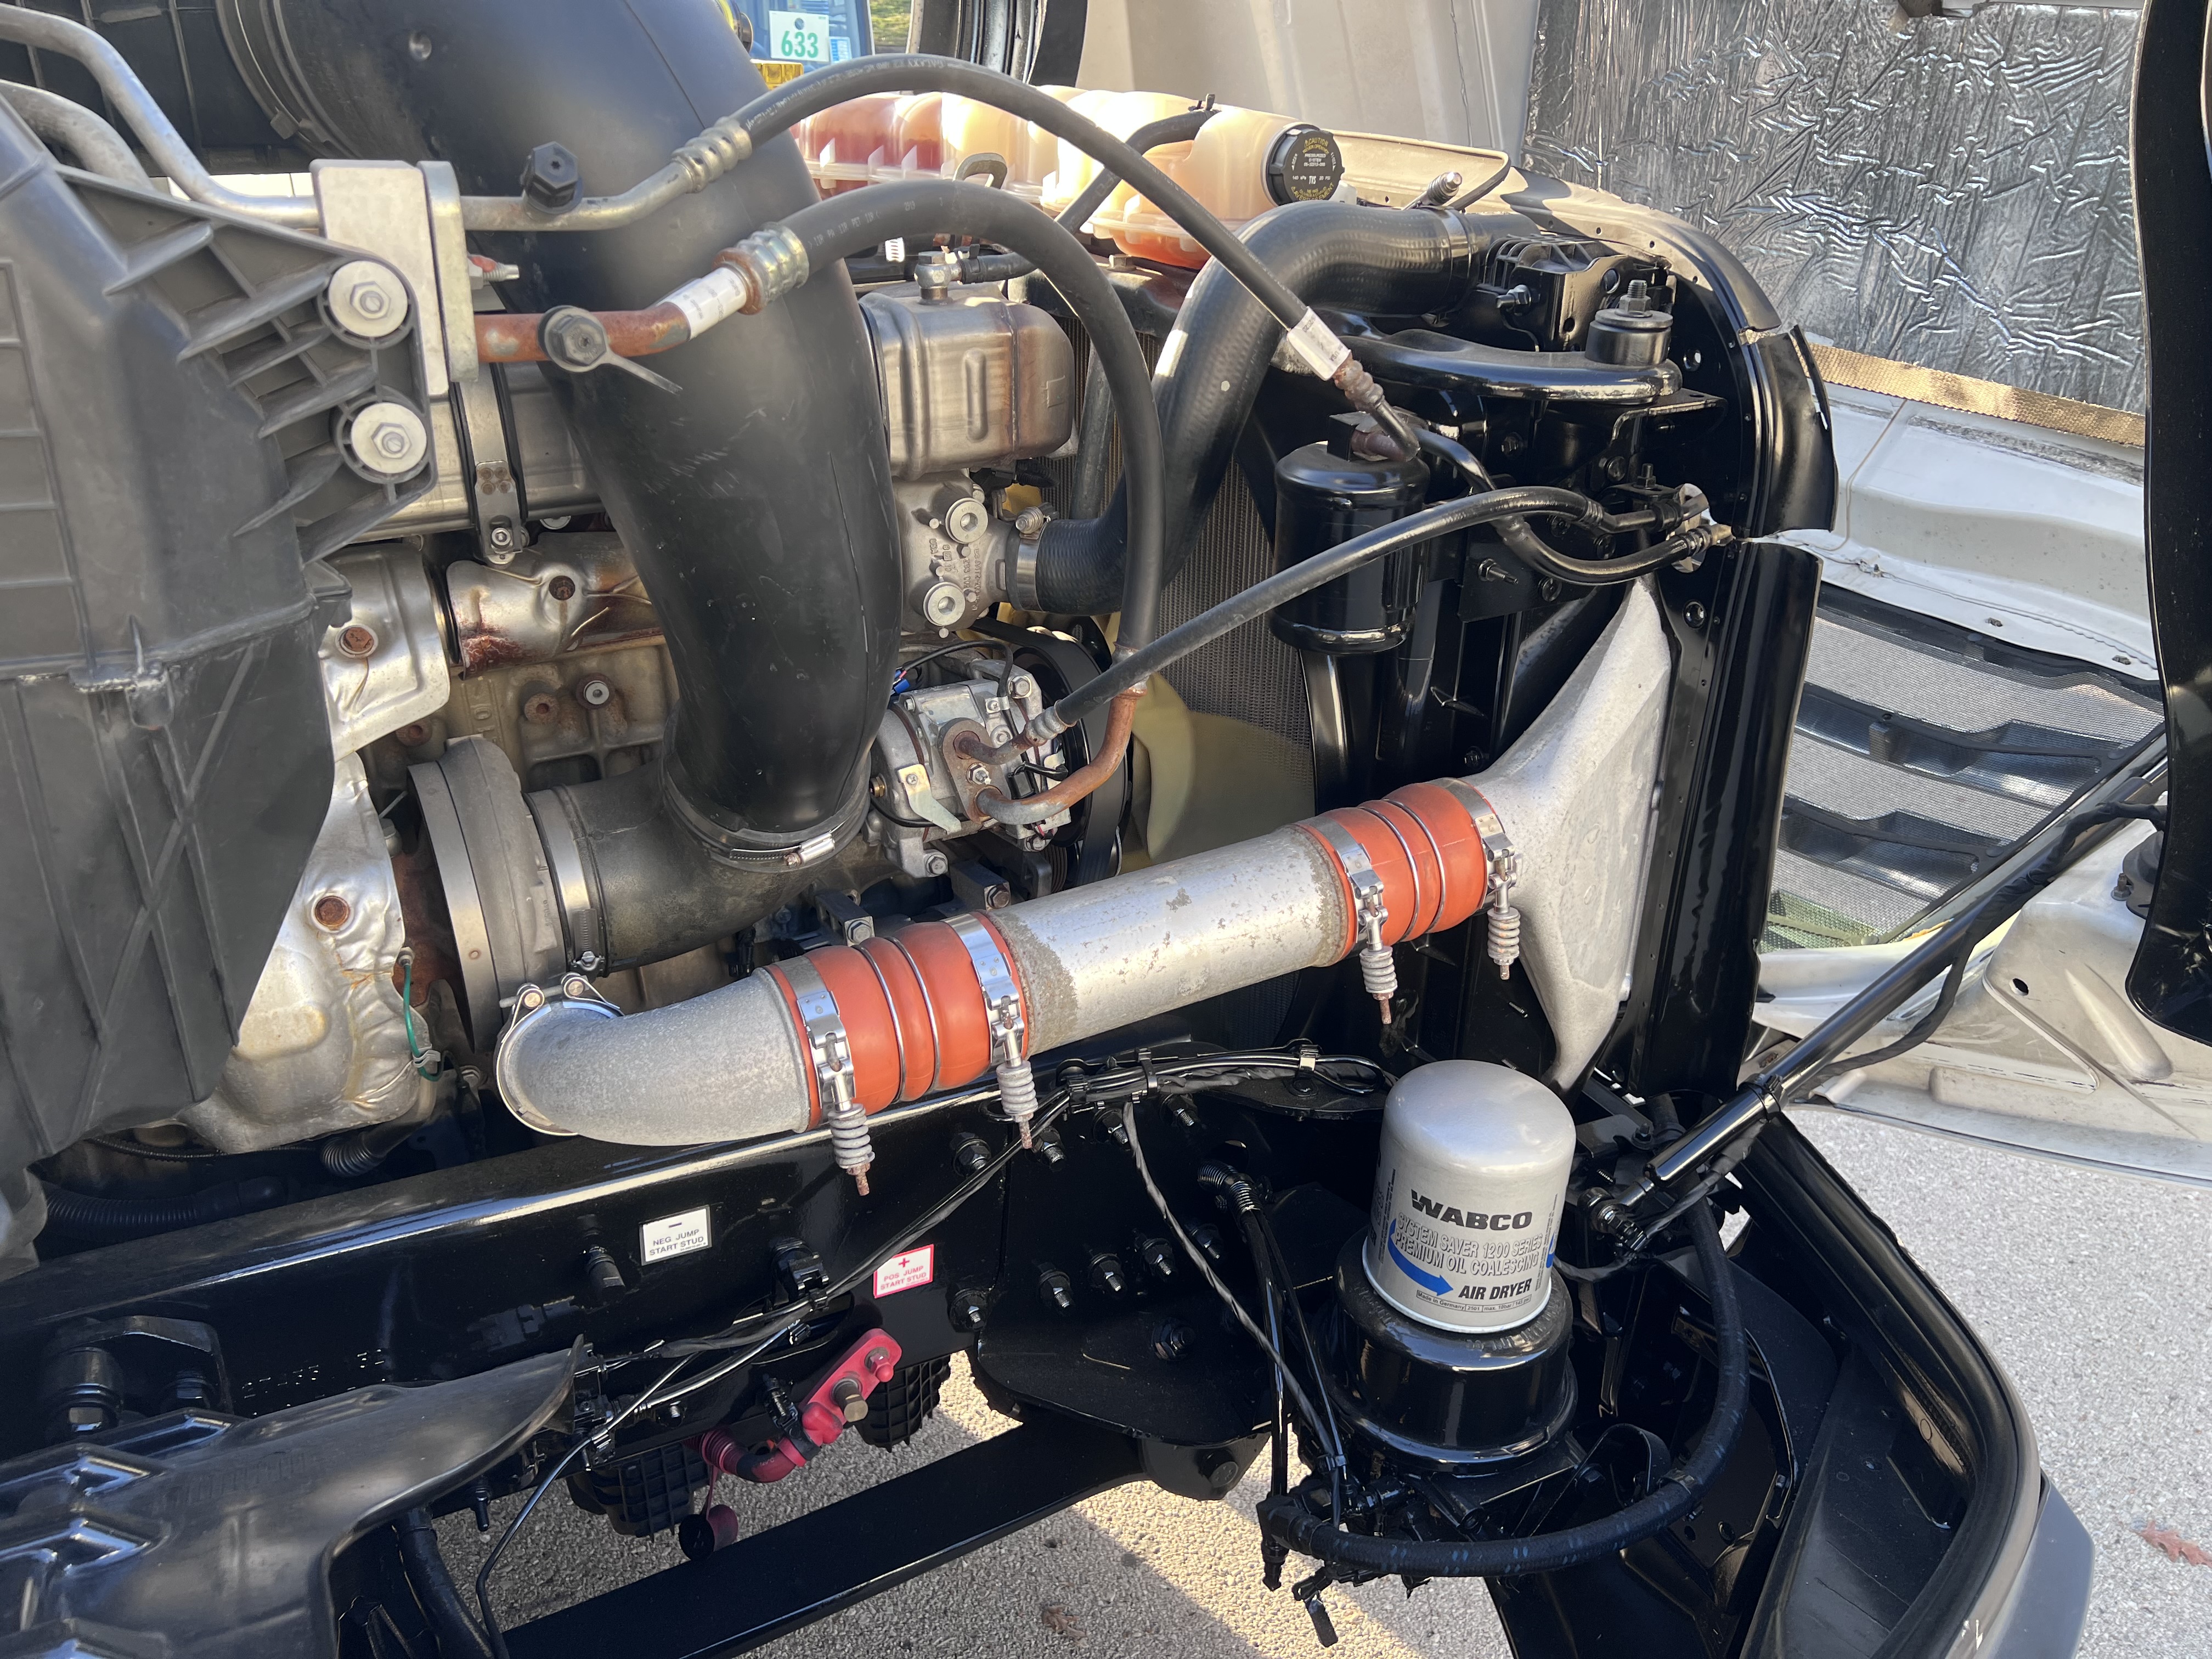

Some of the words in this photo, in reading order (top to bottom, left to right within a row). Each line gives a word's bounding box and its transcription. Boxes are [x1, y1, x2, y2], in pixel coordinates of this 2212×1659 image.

[781, 30, 819, 58] 633
[1309, 137, 1329, 147] CAUTION
[929, 538, 939, 555] USA
[1411, 1189, 1532, 1231] WABCO
[653, 1237, 672, 1246] NEG
[676, 1229, 699, 1240] JUMP
[1397, 1212, 1438, 1248] SYSTEM
[1440, 1235, 1479, 1258] SAVER
[1483, 1242, 1509, 1259] 1200
[1511, 1233, 1543, 1257] SERIES
[650, 1243, 678, 1256] START
[680, 1237, 704, 1248] STUD
[1395, 1228, 1444, 1268] PREMIUM
[1447, 1255, 1466, 1274] OIL
[1470, 1251, 1539, 1276] COALESCING
[881, 1278, 905, 1290] START
[907, 1272, 927, 1282] STUD
[884, 1273, 900, 1282] POS
[903, 1265, 924, 1276] JUMP
[1458, 1285, 1486, 1300] AIR
[1489, 1278, 1532, 1300] DRYER
[1418, 1291, 1432, 1302] Made
[1440, 1300, 1465, 1311] Germany
